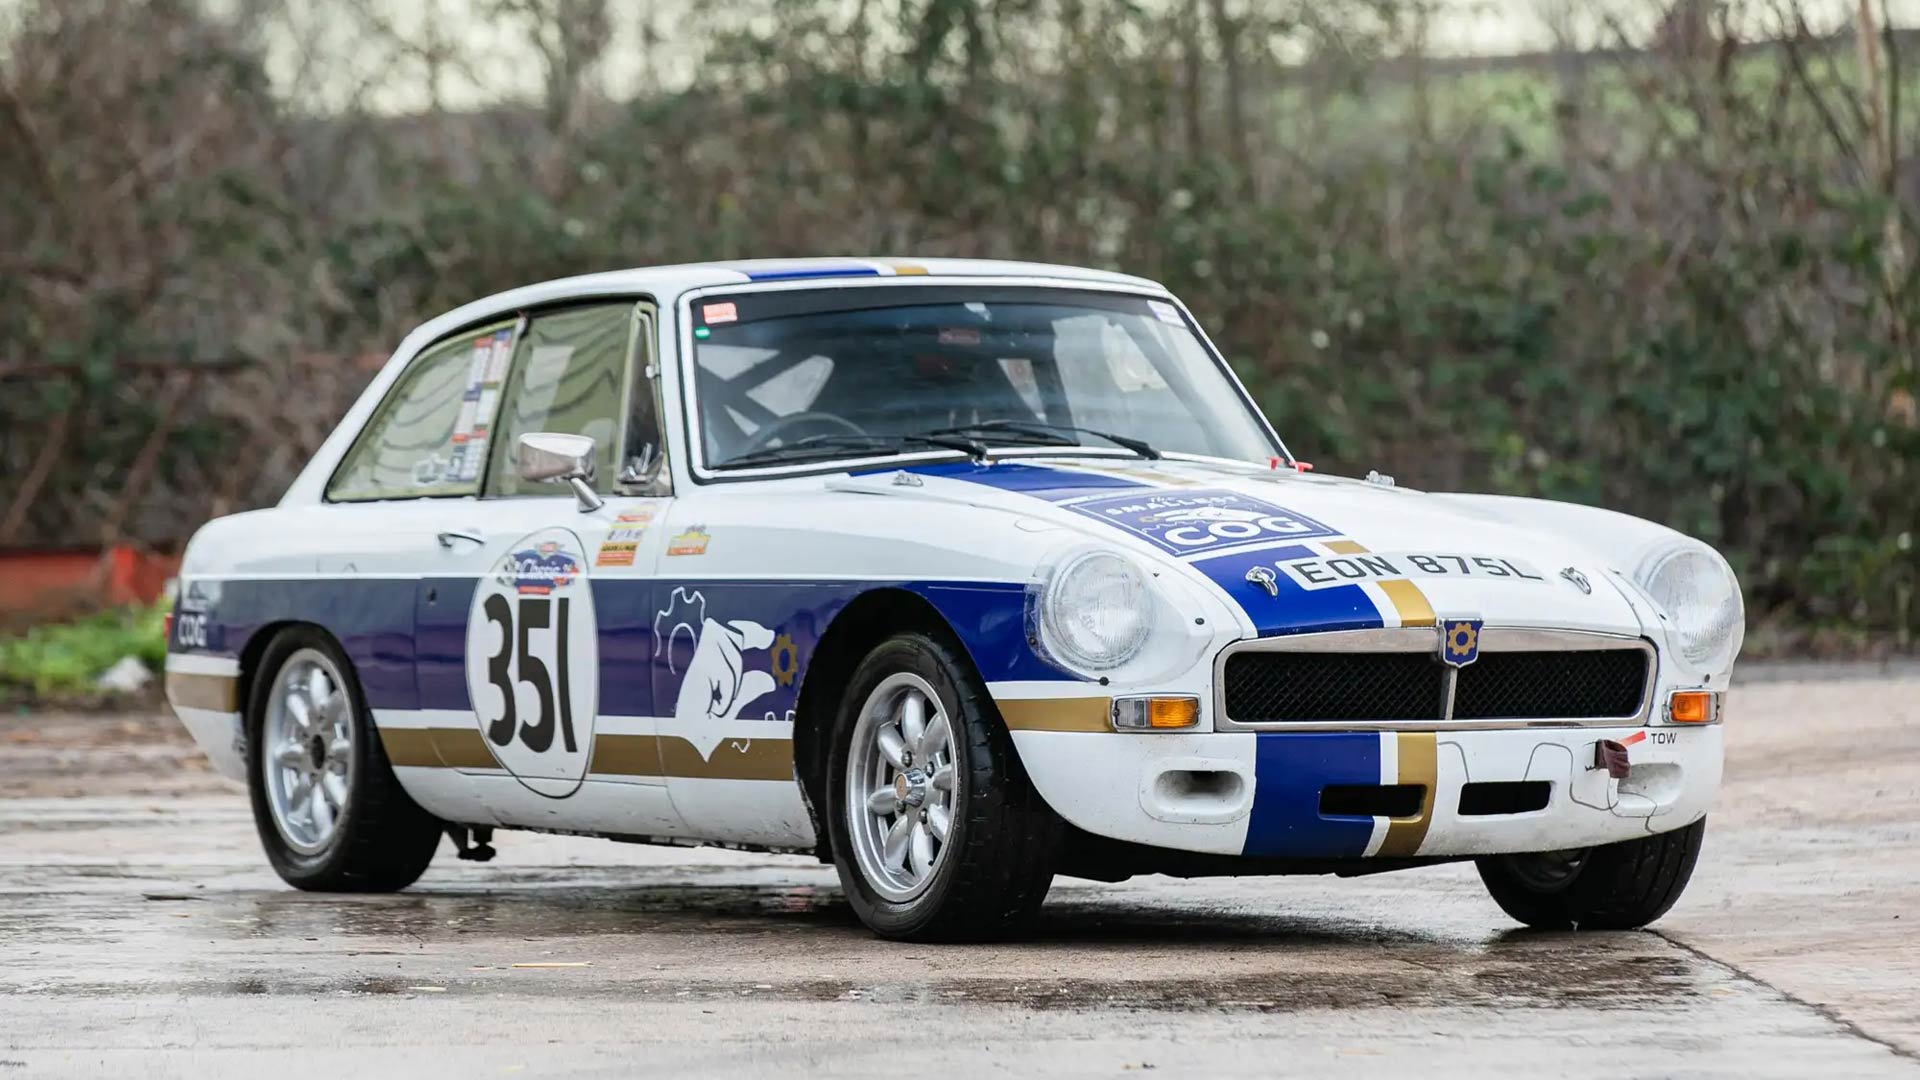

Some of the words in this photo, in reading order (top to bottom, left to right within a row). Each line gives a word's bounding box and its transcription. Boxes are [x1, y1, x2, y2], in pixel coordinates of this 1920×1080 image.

[1105, 496, 1238, 515] SMALLEST
[1165, 517, 1312, 546] COG
[1292, 556, 1402, 584] EON
[1406, 555, 1544, 581] 875L
[484, 593, 577, 753] 351
[1650, 732, 1677, 744] TOW
